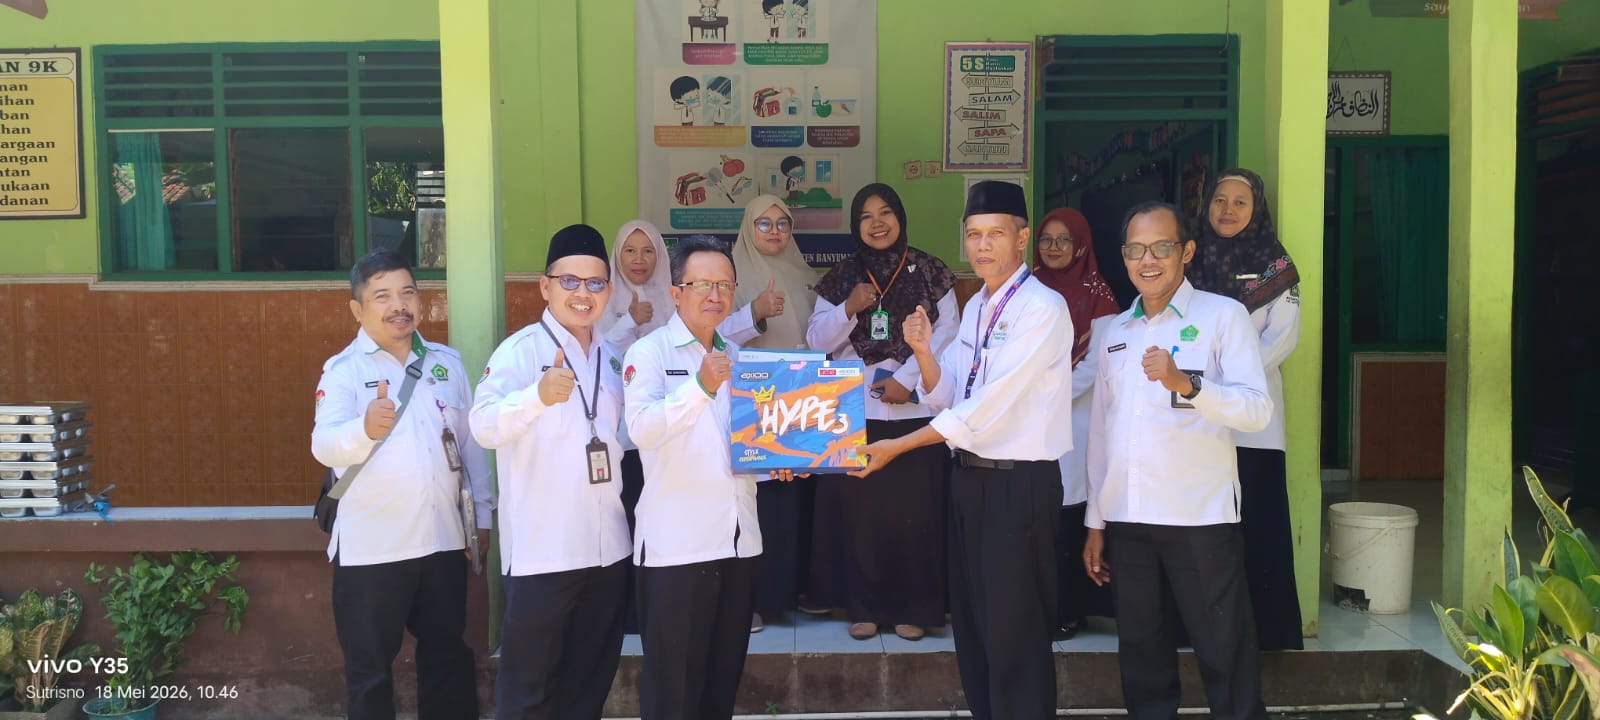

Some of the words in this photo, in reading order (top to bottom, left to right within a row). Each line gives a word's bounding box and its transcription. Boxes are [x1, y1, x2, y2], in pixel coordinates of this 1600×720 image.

[28, 60, 58, 73] 9K
[972, 95, 1012, 104] SALAM
[962, 110, 1001, 120] SALIM
[974, 127, 1006, 138] SAPA
[761, 395, 836, 436] HYPE
[832, 413, 850, 434] 3
